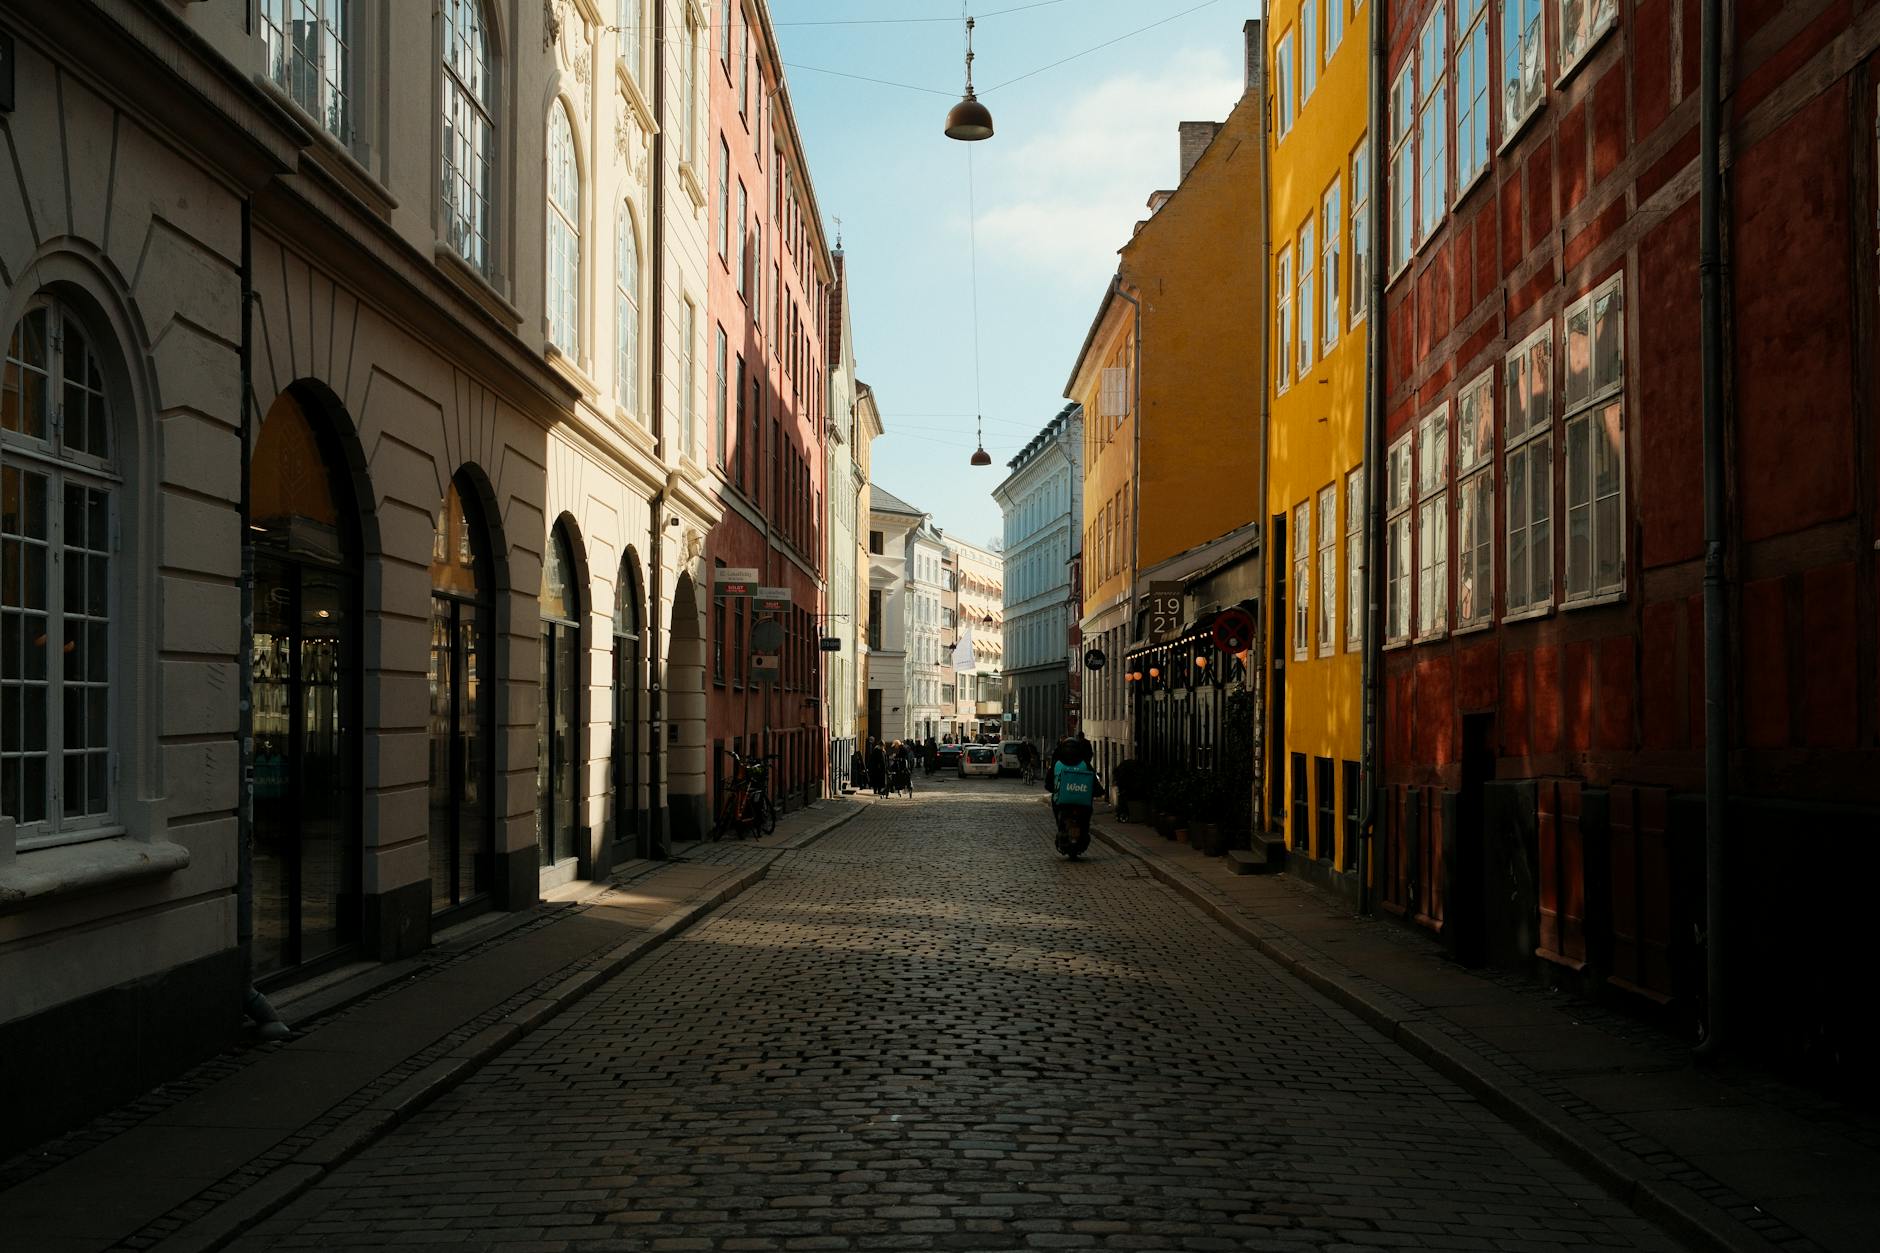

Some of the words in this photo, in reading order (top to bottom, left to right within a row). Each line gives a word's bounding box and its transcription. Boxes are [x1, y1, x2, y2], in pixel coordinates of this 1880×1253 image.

[1153, 598, 1180, 615] 19
[1153, 616, 1177, 633] 21
[1066, 783, 1089, 793] Wolt
